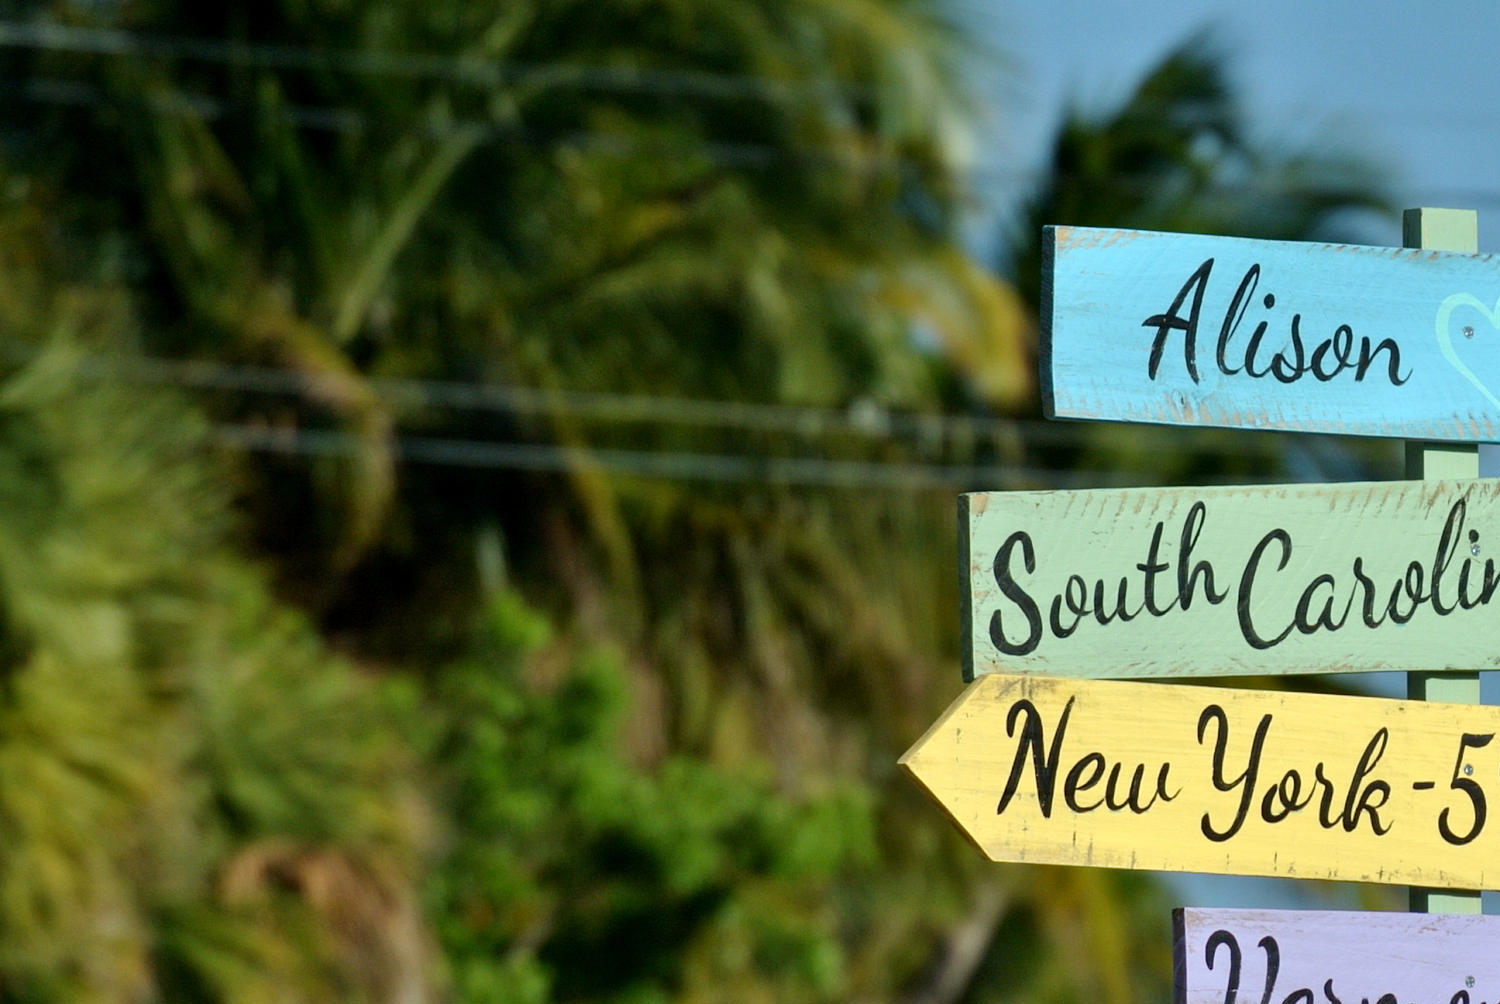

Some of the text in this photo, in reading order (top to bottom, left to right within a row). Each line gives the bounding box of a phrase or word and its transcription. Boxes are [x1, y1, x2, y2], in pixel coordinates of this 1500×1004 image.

[1141, 256, 1412, 385] Alison
[988, 500, 1228, 657] South
[996, 695, 1183, 819] New
